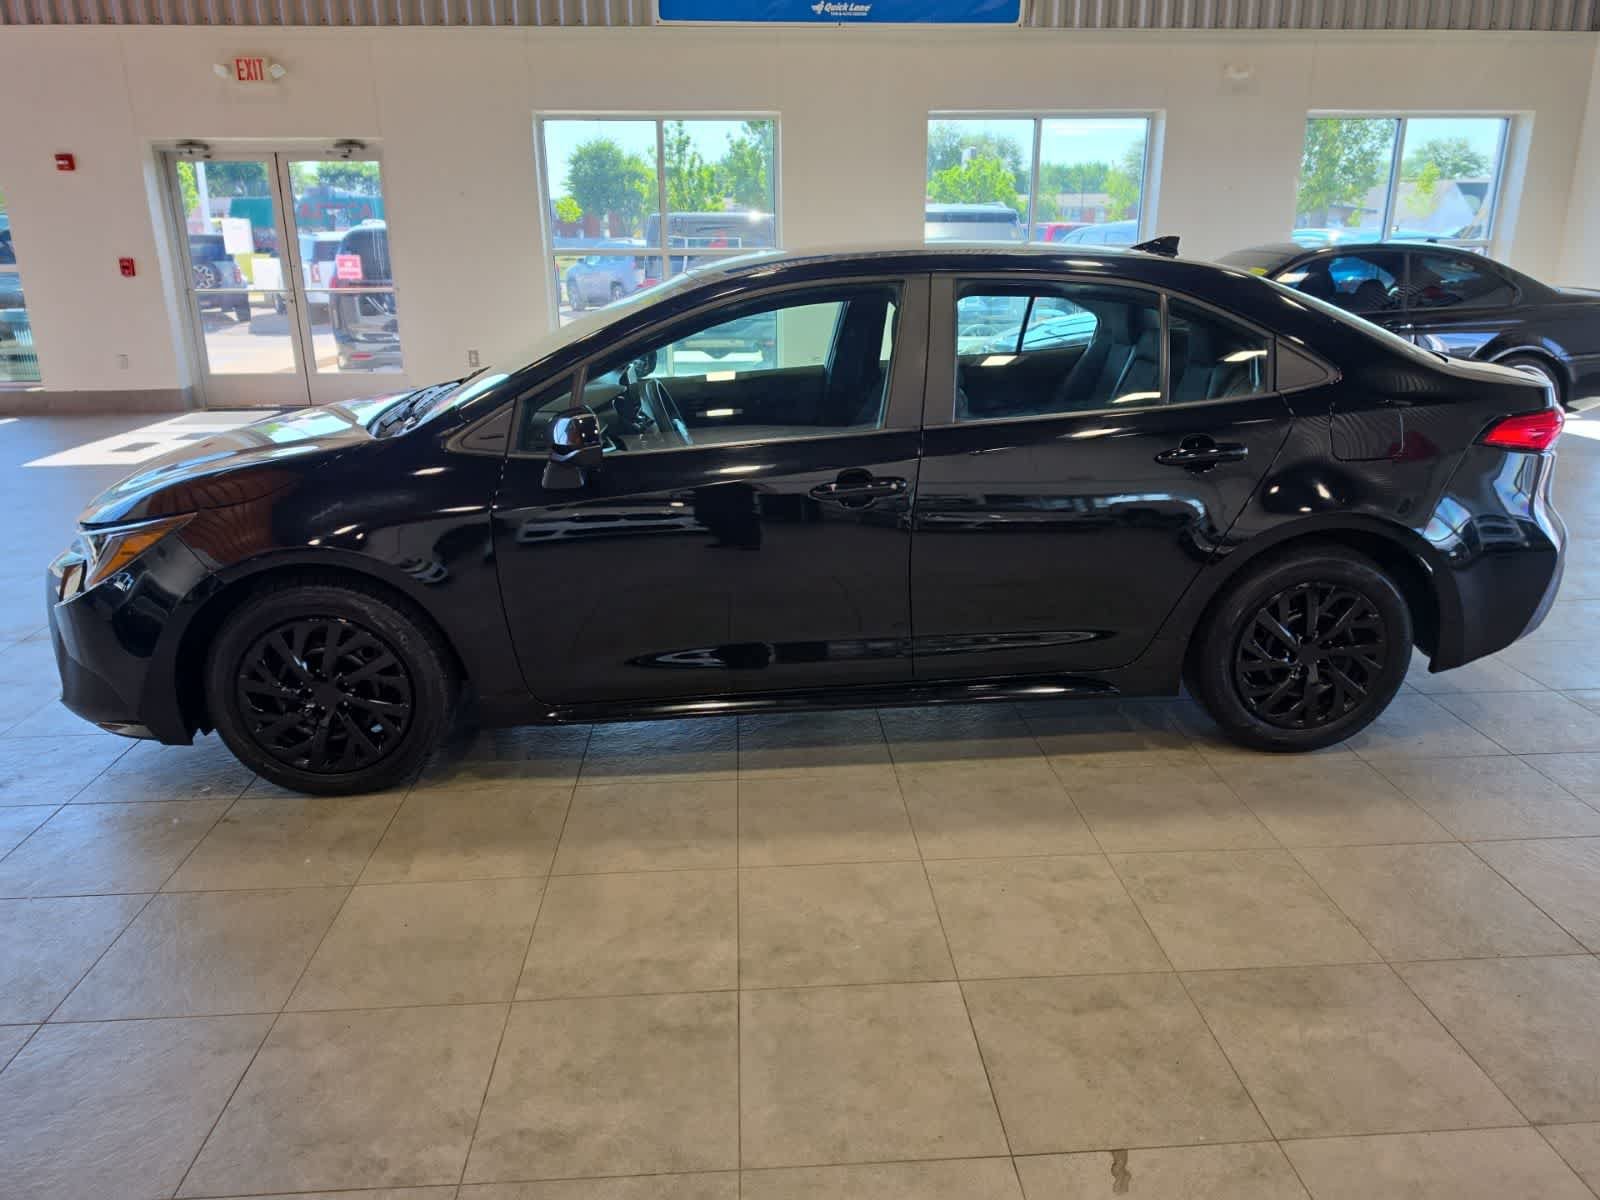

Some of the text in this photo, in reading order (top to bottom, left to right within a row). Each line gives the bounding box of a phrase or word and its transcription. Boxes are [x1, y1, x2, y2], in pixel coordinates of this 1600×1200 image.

[824, 2, 872, 12] Quick Lane
[235, 58, 264, 81] EXIT
